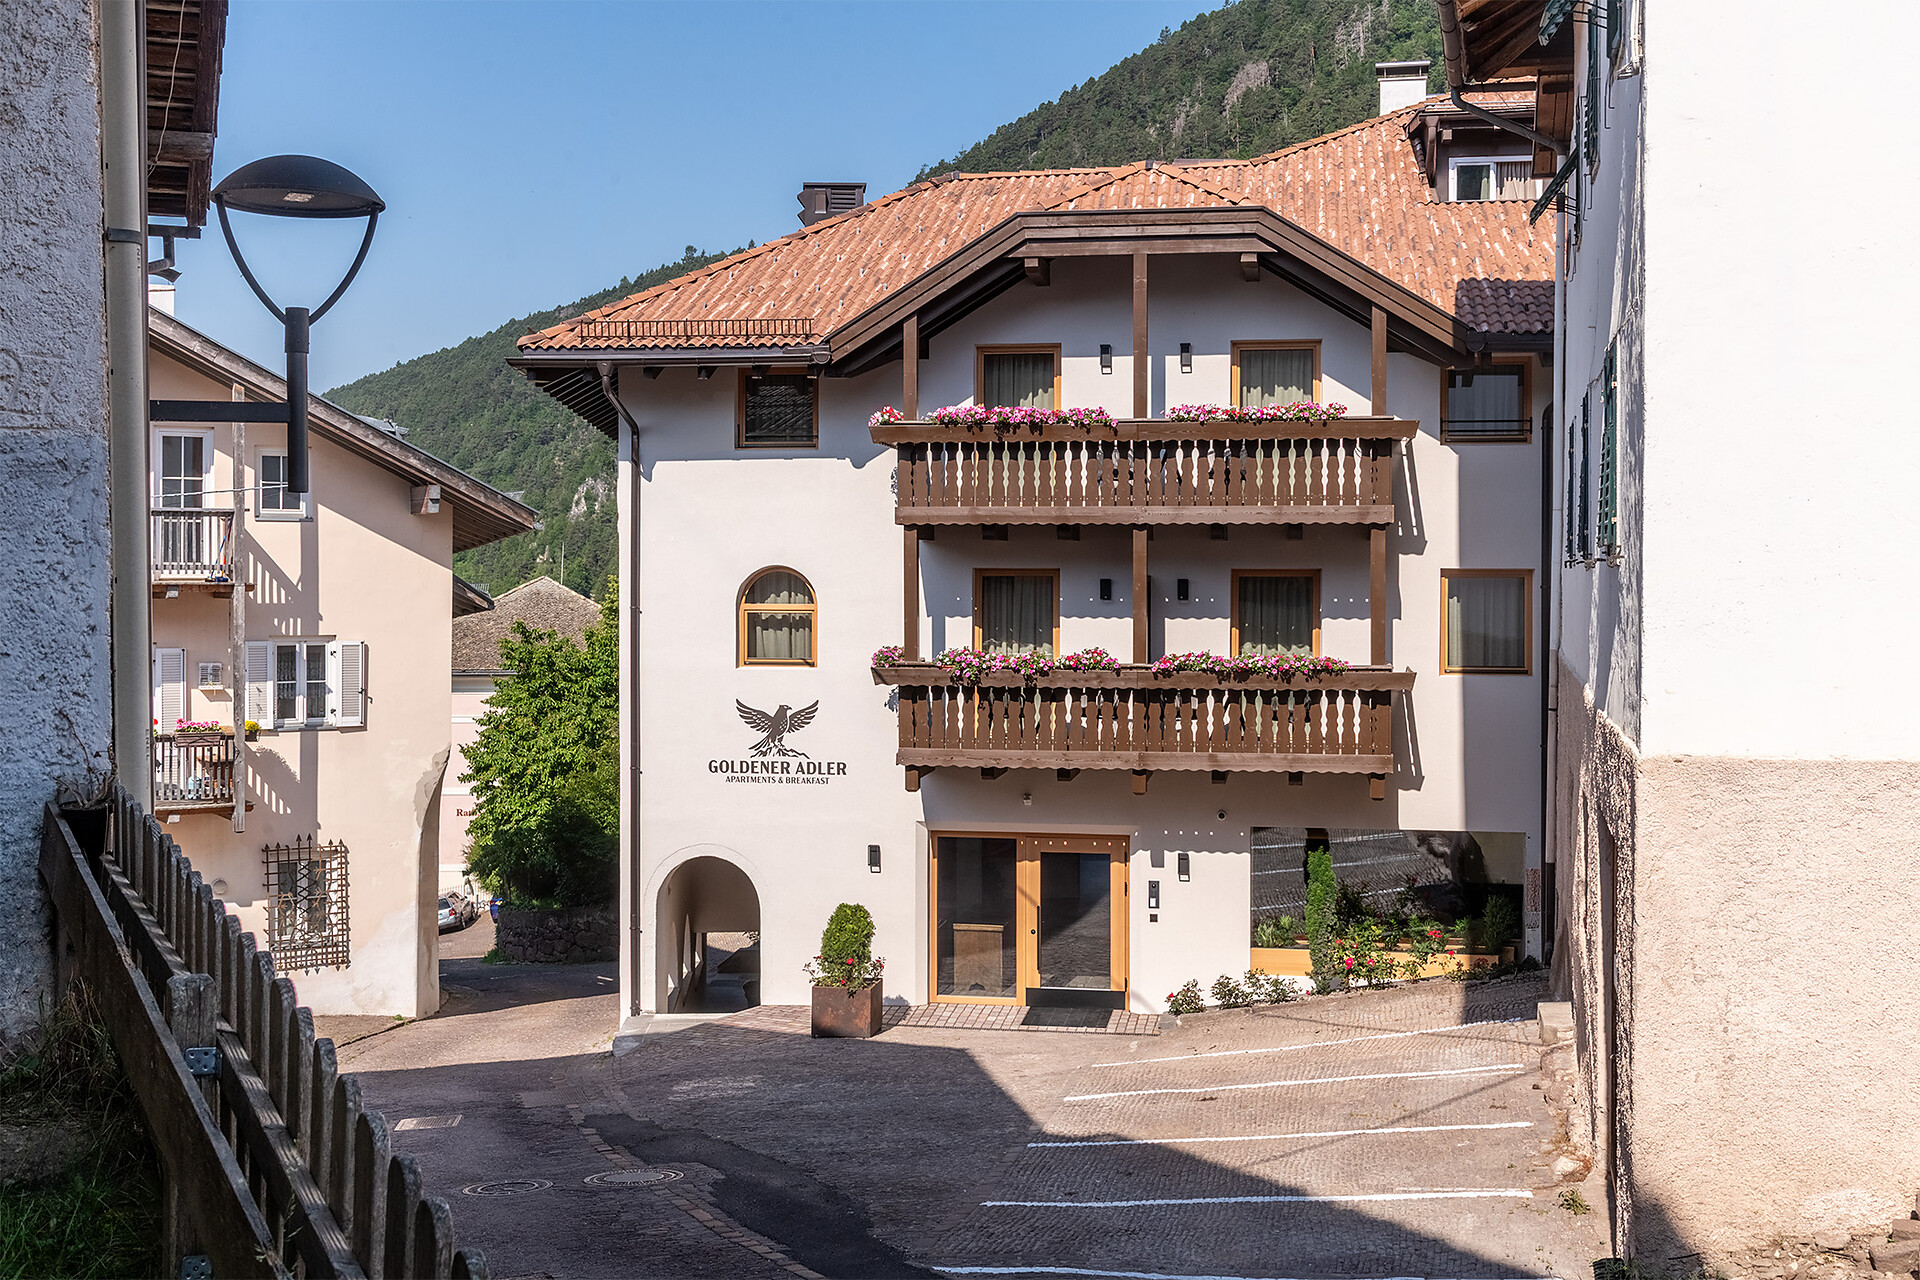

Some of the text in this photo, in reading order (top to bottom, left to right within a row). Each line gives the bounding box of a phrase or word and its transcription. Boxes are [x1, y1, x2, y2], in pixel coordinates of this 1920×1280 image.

[708, 760, 847, 775] GOLDENER ADLER
[725, 775, 830, 785] APARTMENTS & BREAKFAST
